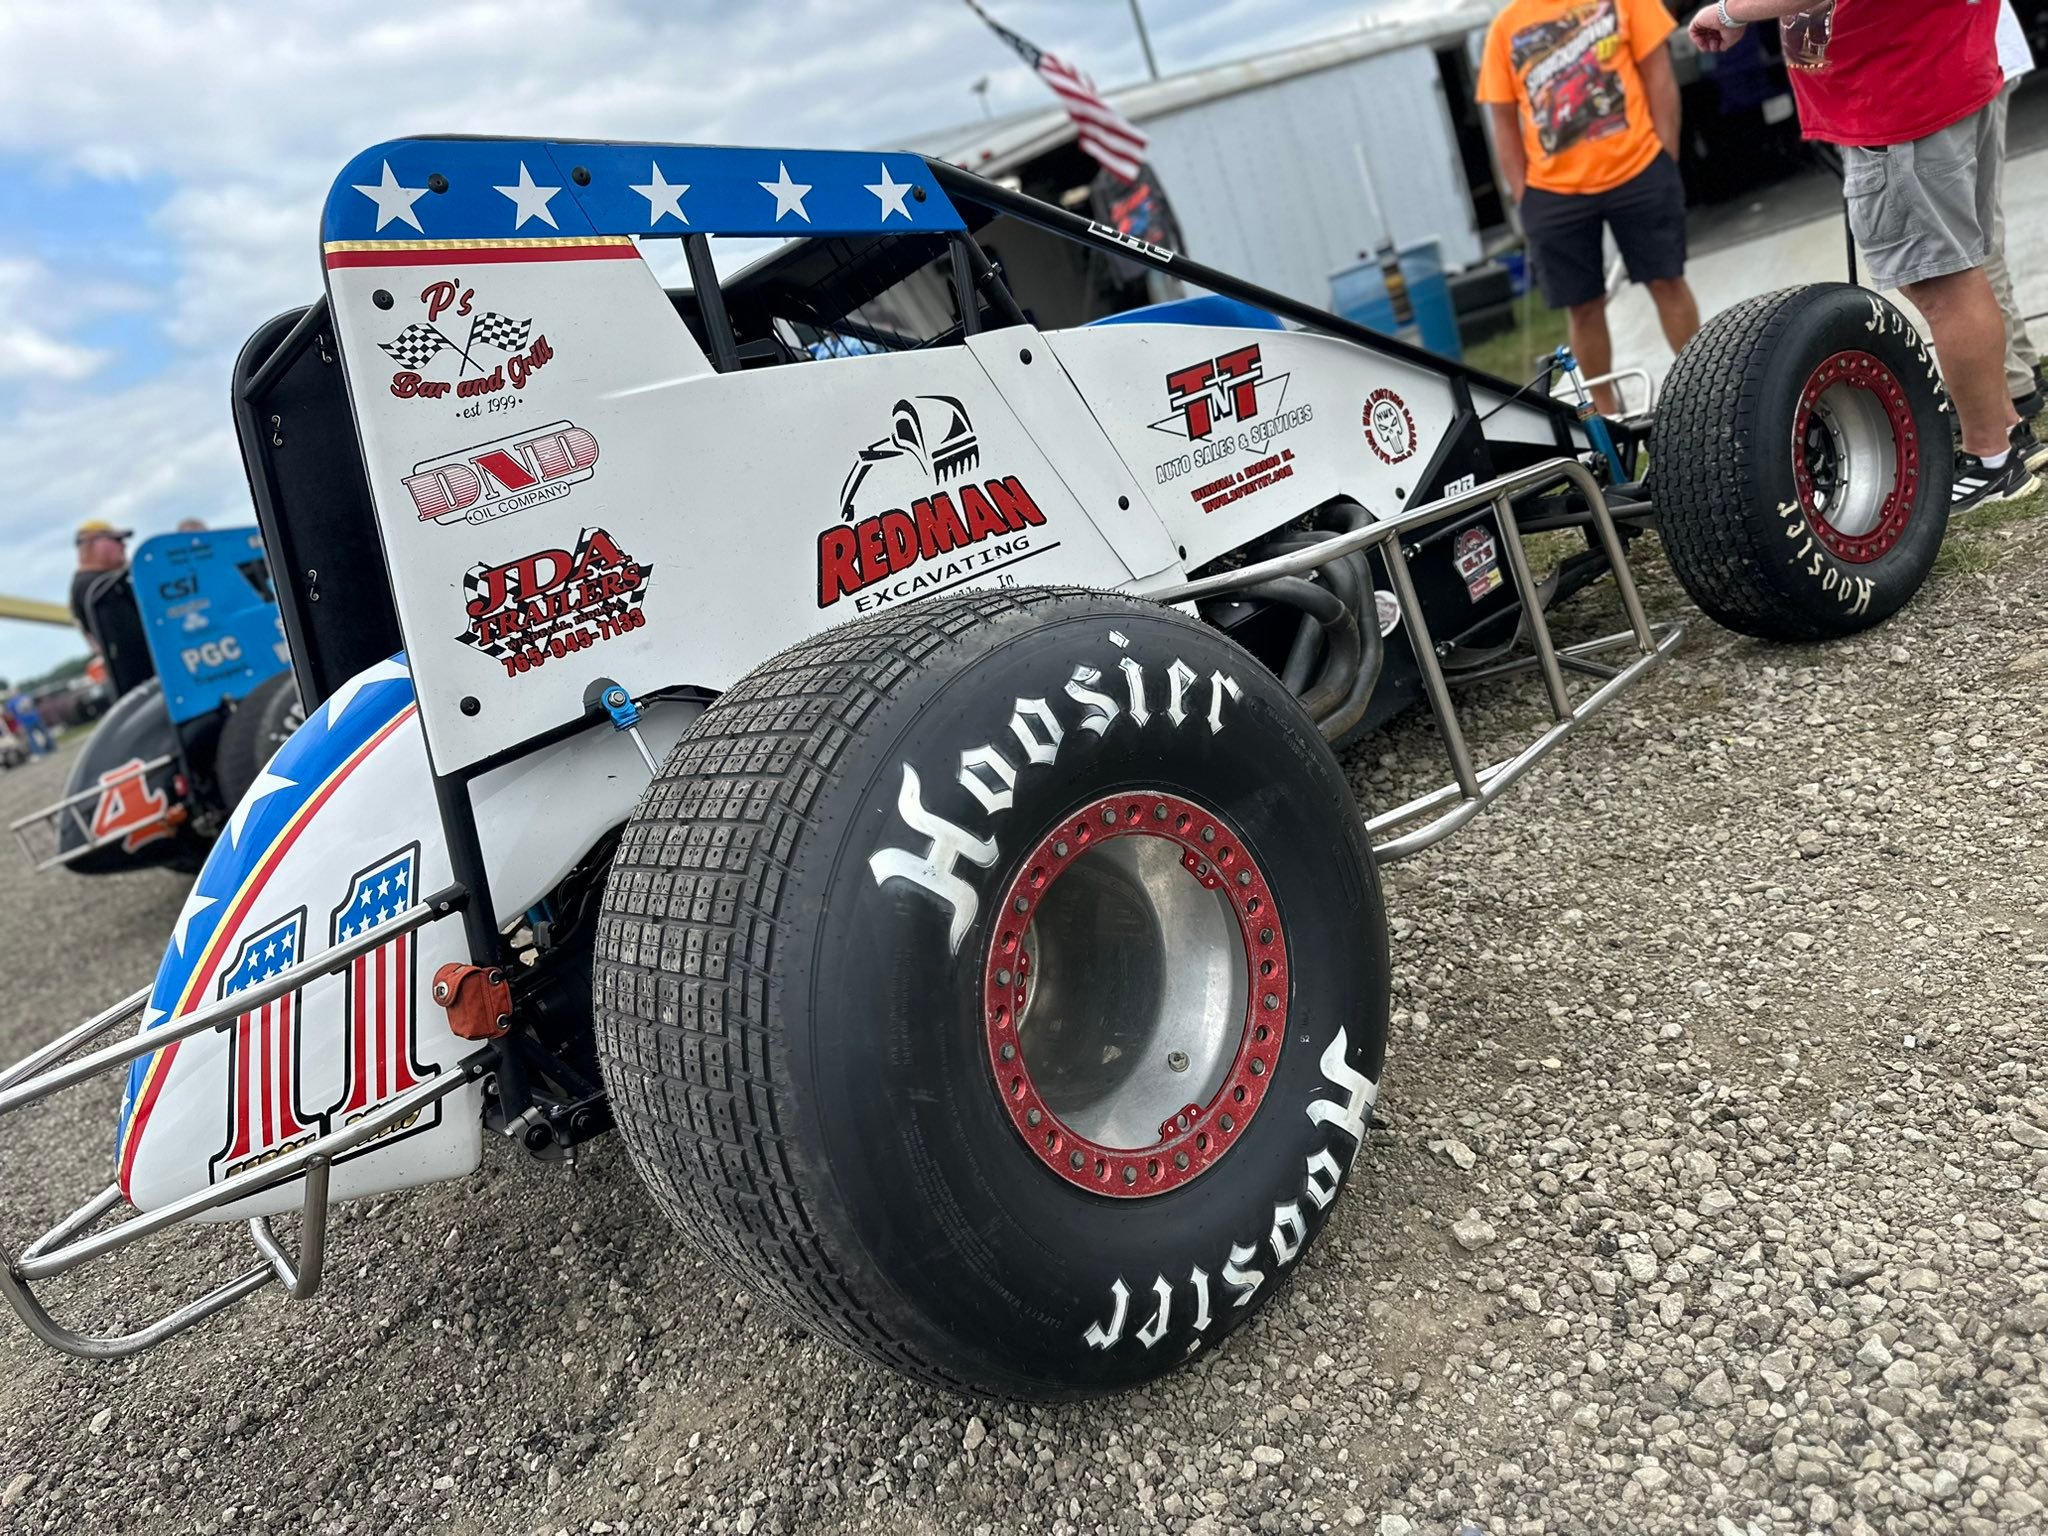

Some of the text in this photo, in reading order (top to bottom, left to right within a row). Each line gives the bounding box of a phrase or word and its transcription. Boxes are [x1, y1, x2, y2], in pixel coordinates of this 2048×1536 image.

[421, 278, 475, 322] P's
[390, 334, 553, 399] Bar and Grill
[463, 395, 516, 419] est 1999
[1155, 404, 1313, 484] AUTO SALES & SERVICES
[400, 426, 600, 522] DND
[472, 485, 563, 522] OIL COMPANY
[1190, 474, 1236, 502] WINDFALL
[1243, 454, 1281, 479] KOKOMO
[466, 530, 632, 617] JDA
[817, 475, 1047, 608] REDMAN
[855, 535, 1031, 614] EXCAVATING
[1777, 500, 1876, 616] Hoosier
[471, 562, 642, 647] TRAILERS
[501, 607, 646, 678] 765-945-7133
[573, 601, 623, 625] INDIANA
[180, 636, 242, 674] PGC
[90, 758, 169, 853] 4
[868, 629, 1243, 957] Hoosier
[1083, 1025, 1380, 1354] Hoosier
